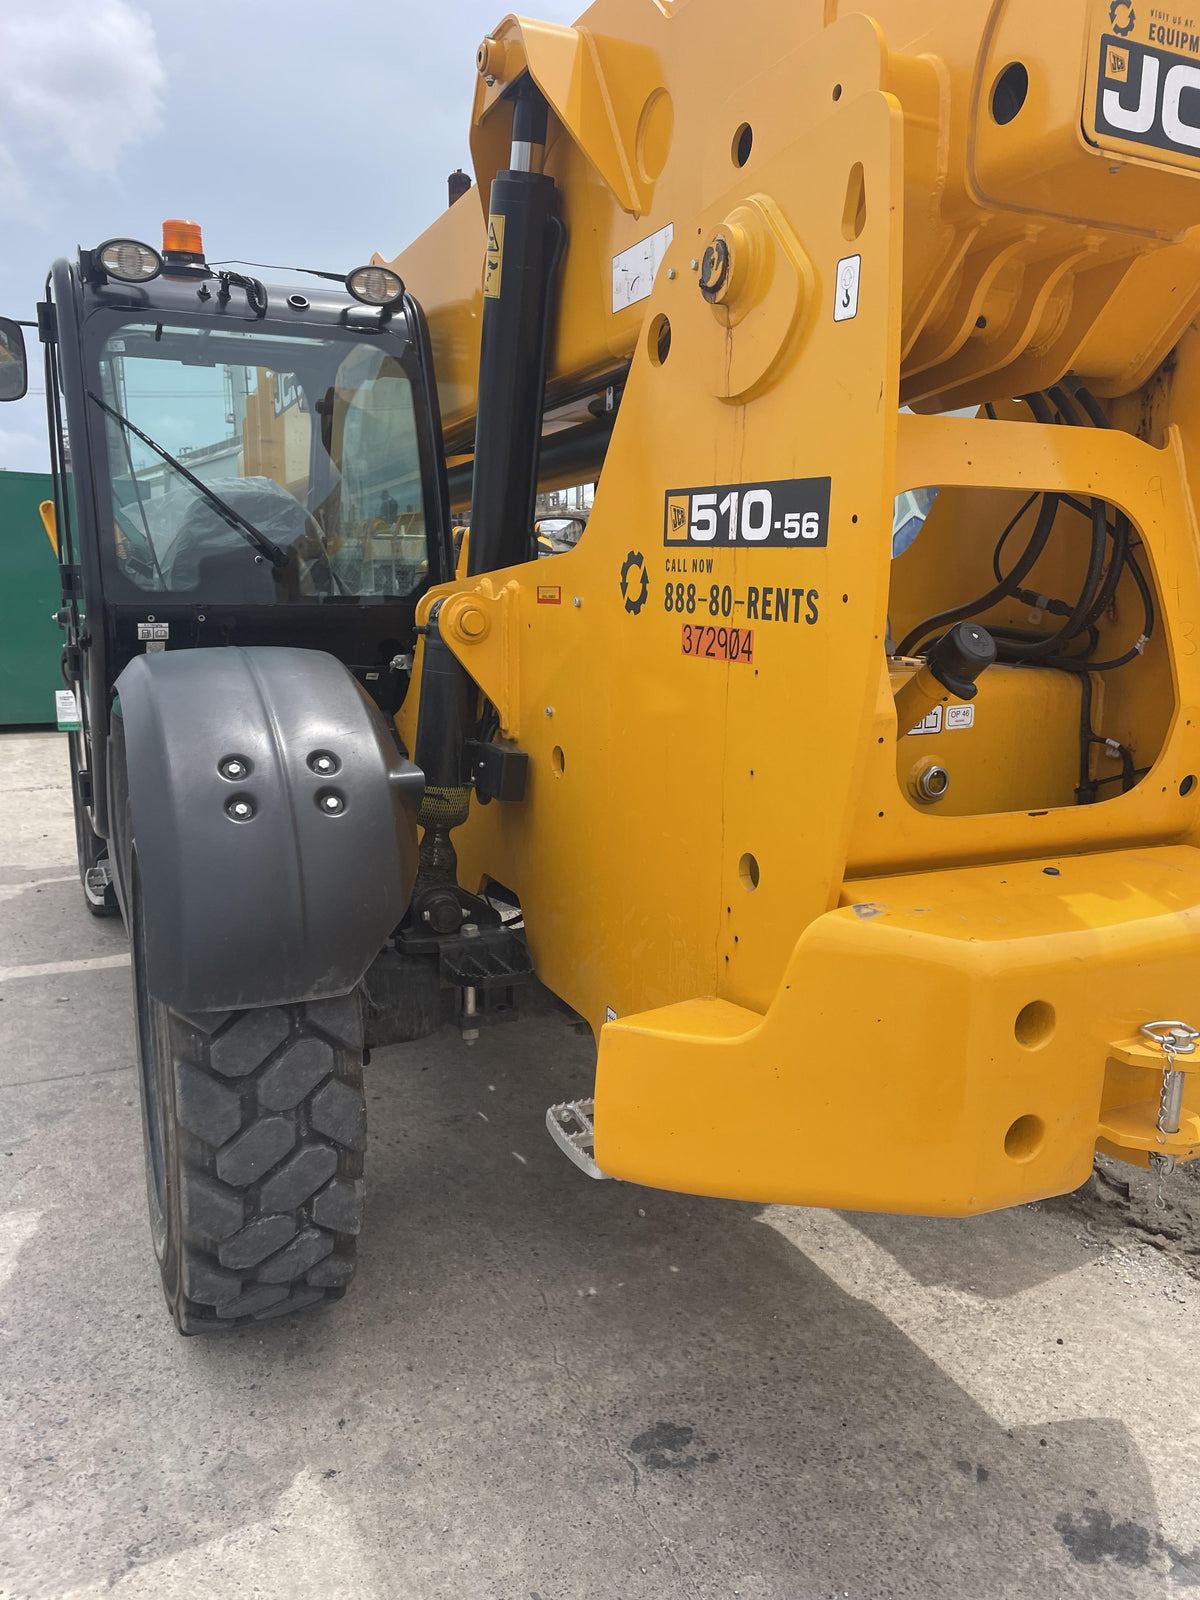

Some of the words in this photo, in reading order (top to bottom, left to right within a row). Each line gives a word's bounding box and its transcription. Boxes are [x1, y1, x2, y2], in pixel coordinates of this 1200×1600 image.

[1150, 9, 1169, 21] VISIT
[1173, 16, 1181, 24] US
[1149, 23, 1200, 53] EQUIPM
[1111, 53, 1126, 71] JCB
[671, 506, 686, 530] JCB
[665, 558, 687, 572] CALL
[692, 559, 713, 573] NOW
[664, 582, 819, 625] 888-80-RENTS
[682, 624, 753, 661] 372904
[950, 710, 960, 718] OP
[962, 709, 970, 717] 46
